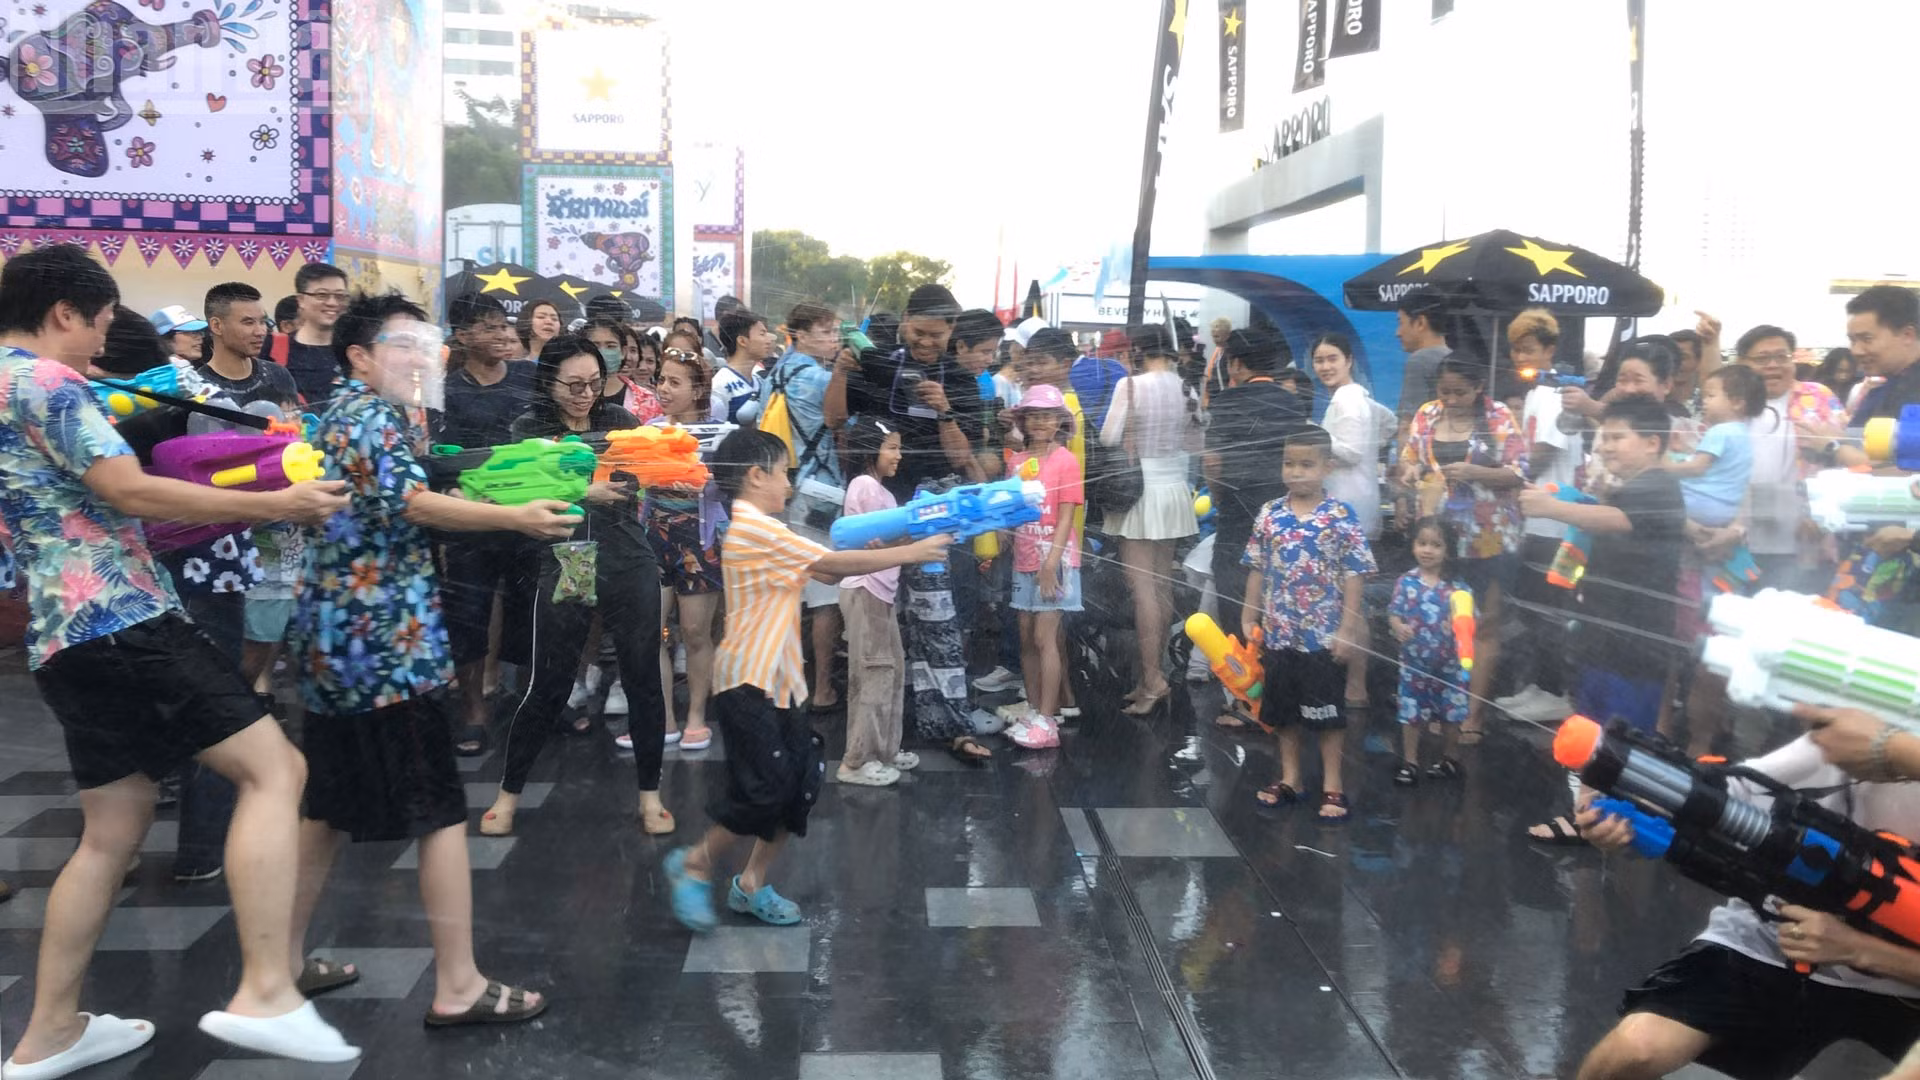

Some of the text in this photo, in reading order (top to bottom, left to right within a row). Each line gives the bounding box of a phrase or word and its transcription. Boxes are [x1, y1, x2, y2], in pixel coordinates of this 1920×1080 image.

[1226, 45, 1238, 118] SAPPORO
[572, 112, 625, 124] SAPPORO
[1378, 282, 1430, 302] SAPP
[1527, 282, 1610, 306] SAPPORO
[1098, 307, 1187, 318] BEVEY HLS
